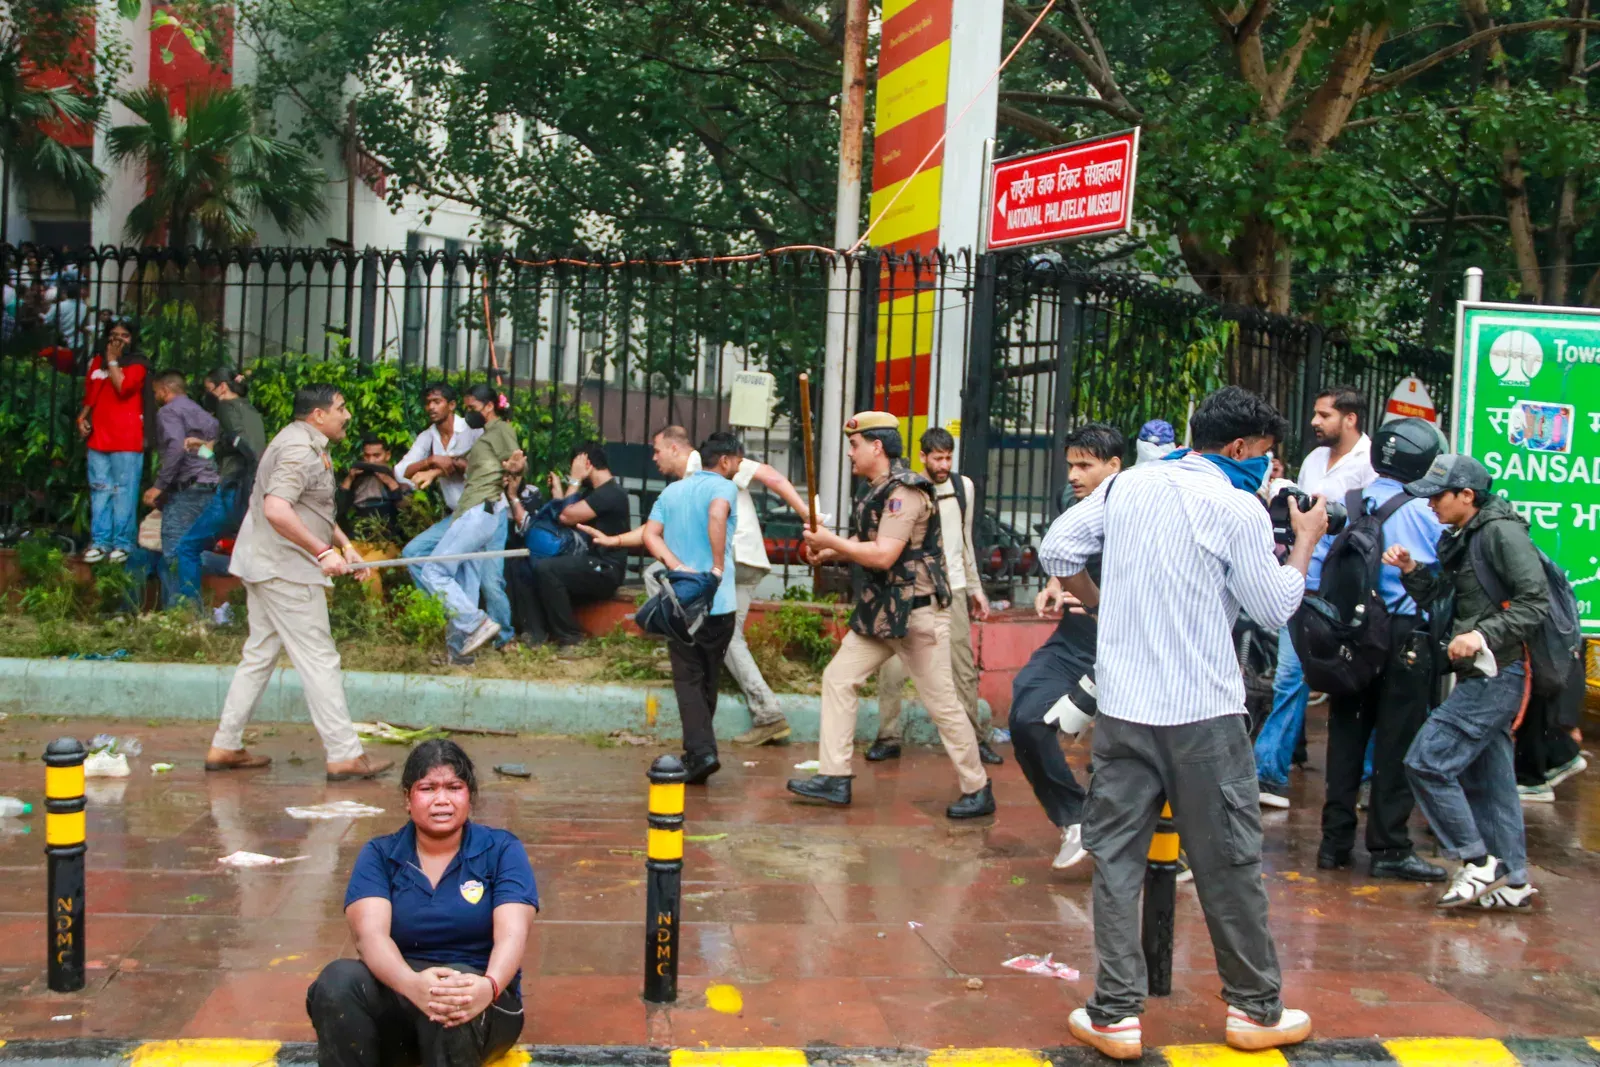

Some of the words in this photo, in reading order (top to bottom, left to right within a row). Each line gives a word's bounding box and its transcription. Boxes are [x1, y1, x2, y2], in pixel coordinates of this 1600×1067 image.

[1007, 204, 1043, 230] NATIONAL
[1044, 196, 1087, 224] PHILATELIC
[1086, 190, 1122, 217] MUSEUM
[1010, 170, 1036, 205] राष्ट्रीय
[1037, 172, 1056, 196] डाक
[1056, 163, 1082, 193] टिकट
[1084, 159, 1123, 187] संग्रहालय
[57, 897, 73, 966] NDMC
[656, 911, 672, 977] NDMC
